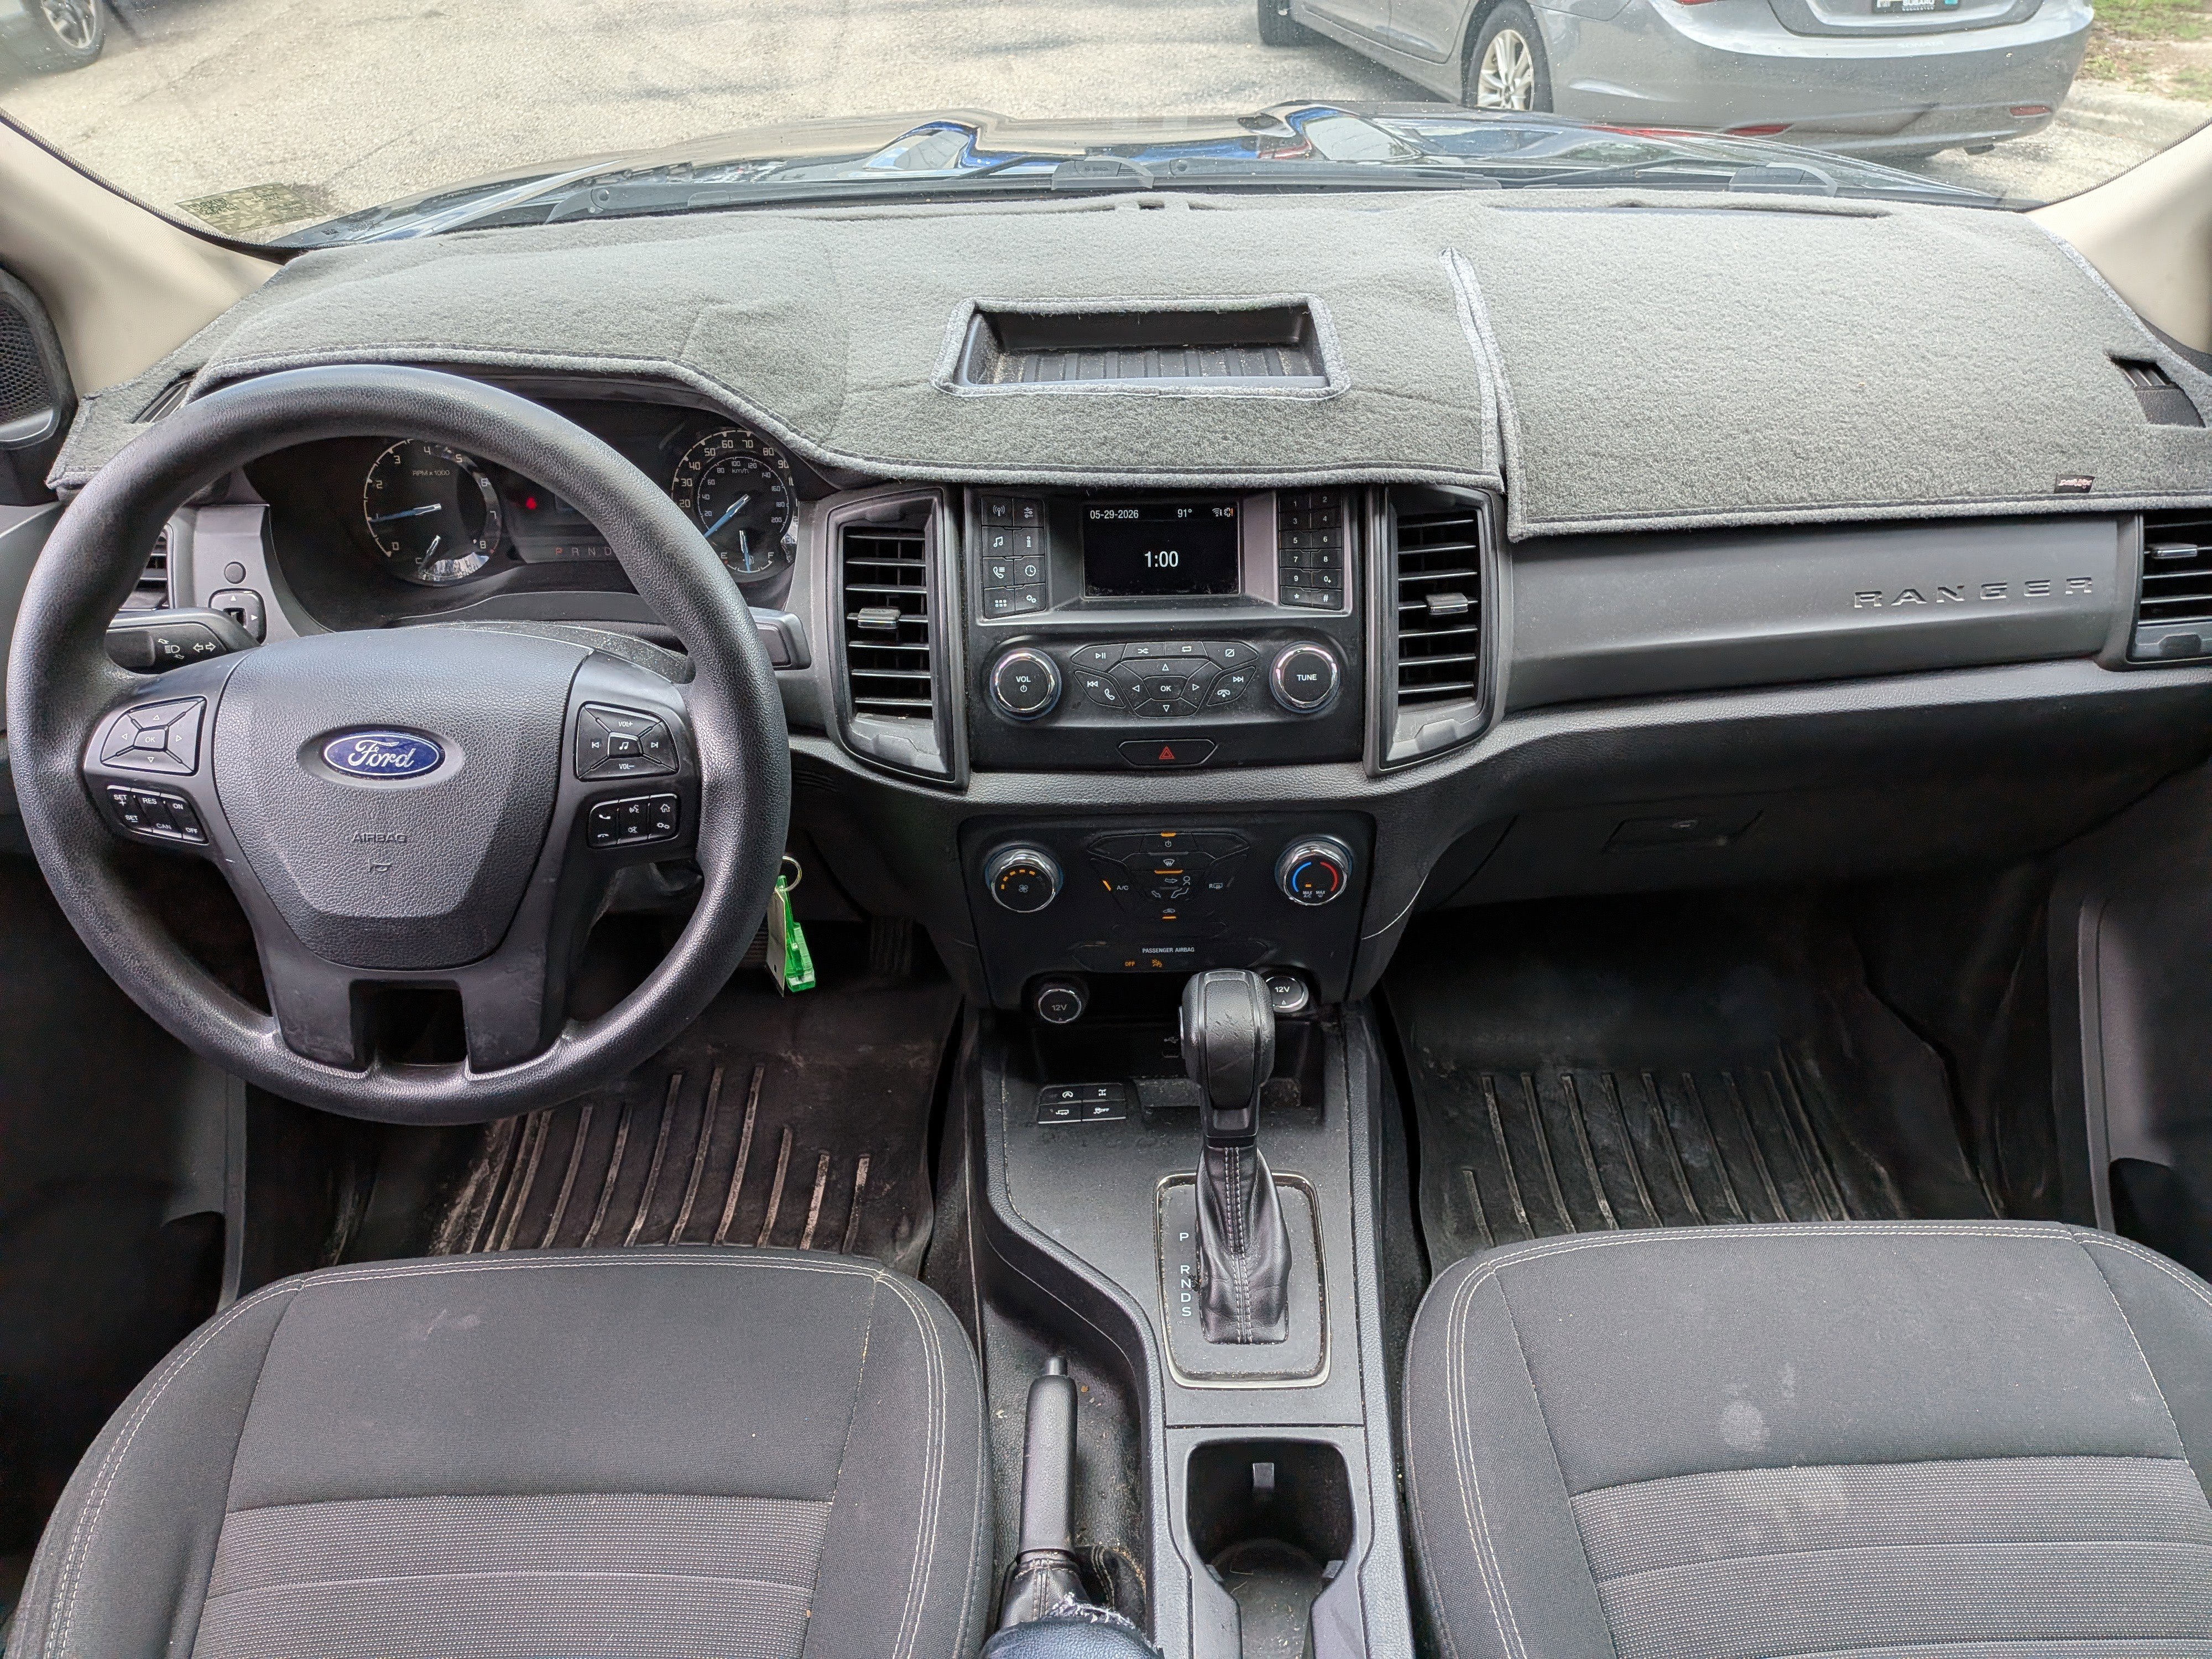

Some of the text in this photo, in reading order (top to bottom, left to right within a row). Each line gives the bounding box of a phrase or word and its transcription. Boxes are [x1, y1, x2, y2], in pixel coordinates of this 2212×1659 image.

[722, 440, 733, 448] 60
[424, 446, 431, 455] 4
[705, 448, 716, 457] 50
[394, 455, 400, 464] 3
[456, 454, 462, 462] 5
[689, 462, 701, 470] 40
[778, 460, 789, 468] 90
[376, 480, 383, 489] 2
[481, 478, 488, 487] 6
[681, 478, 692, 487] 30
[490, 511, 497, 520] 7
[1090, 509, 1192, 519] 05-29-2026 91°
[392, 542, 399, 550] 0
[480, 540, 486, 549] 8
[555, 546, 612, 556] P R N D
[1144, 551, 1179, 567] 1:00
[1854, 577, 2092, 608] RANGER
[348, 739, 416, 768] Ford
[352, 832, 408, 843] AIRBAG
[1180, 1233, 1189, 1241] P
[1180, 1265, 1190, 1274] R
[1181, 1280, 1191, 1288] N
[1181, 1293, 1191, 1302] D
[1182, 1307, 1191, 1316] S
